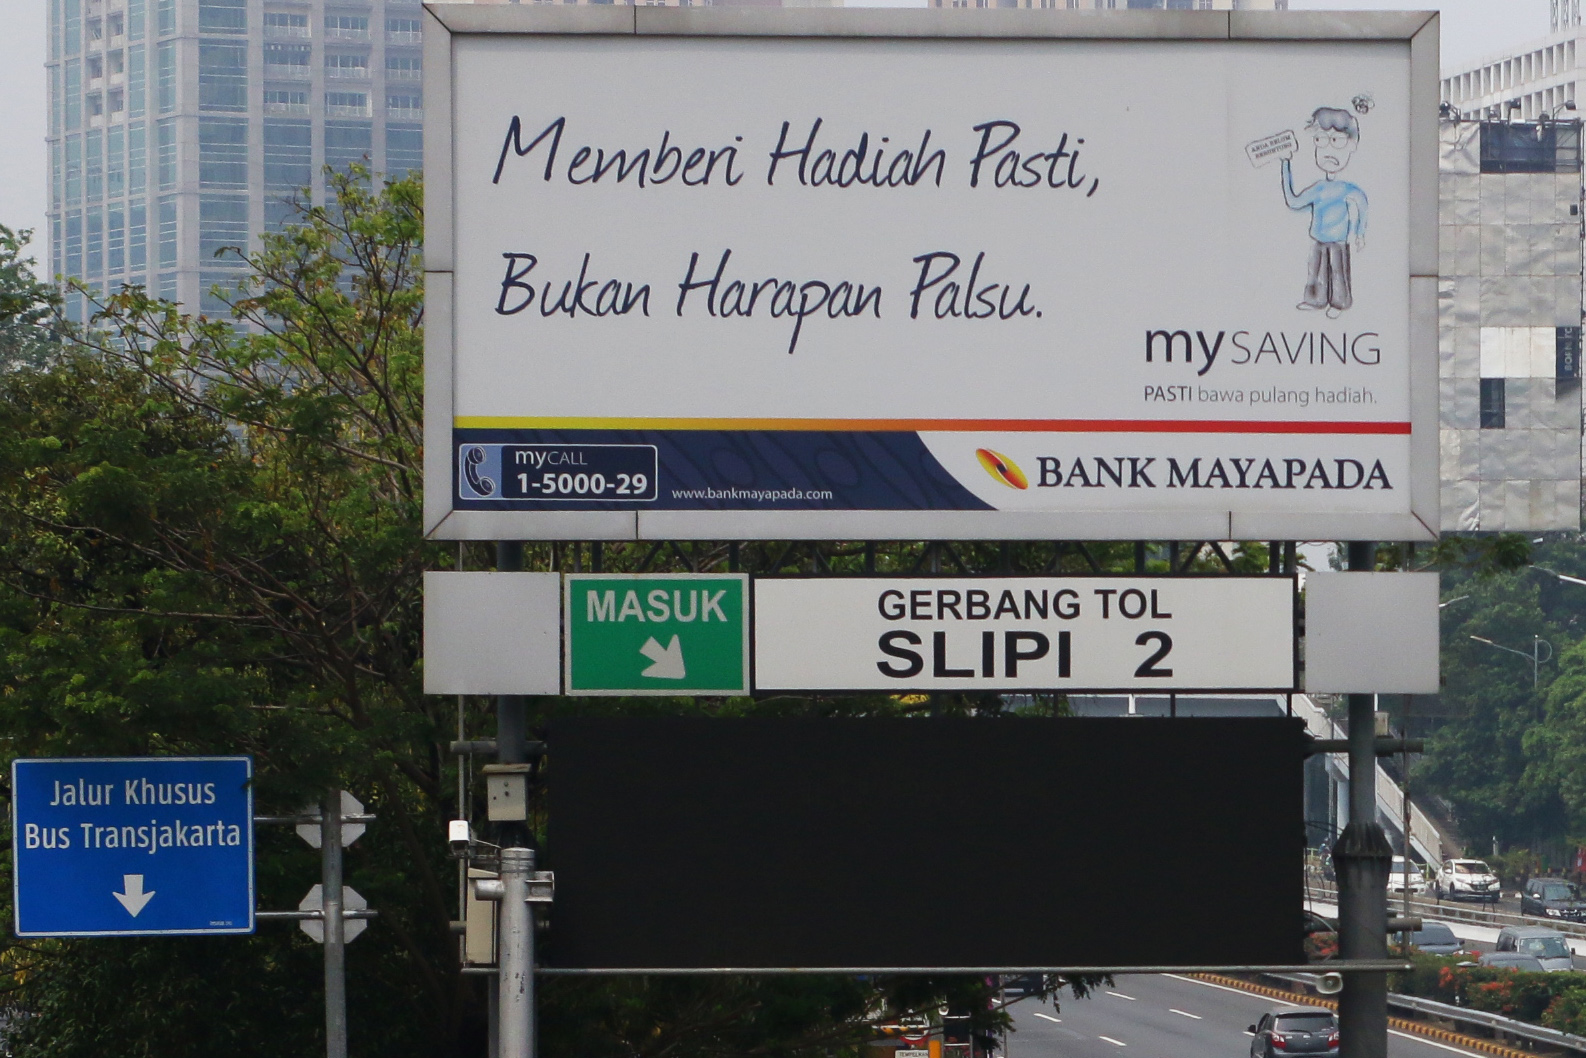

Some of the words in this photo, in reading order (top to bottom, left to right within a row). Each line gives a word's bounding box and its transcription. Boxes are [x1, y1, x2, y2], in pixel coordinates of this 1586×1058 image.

[493, 114, 743, 189] Memberi
[766, 115, 947, 188] Hadiah
[968, 118, 1100, 198] Pasti,
[494, 250, 650, 318] Bukan
[675, 248, 883, 355] Harapan
[908, 250, 1044, 320] Palsu.
[1143, 385, 1193, 402] PASTI
[1198, 385, 1245, 403] bawa
[1249, 385, 1310, 408] pulang
[1314, 385, 1378, 404] hadiah.
[515, 449, 588, 469] myCALL
[1036, 456, 1156, 490] BANK
[1166, 457, 1394, 490] MAYAPADA
[516, 473, 648, 495] 1-5000-29
[672, 486, 833, 502] www.bankmayapada.com
[585, 588, 728, 623] MASUK
[877, 588, 1081, 622] GERBANG
[1093, 588, 1173, 622] TOL
[876, 629, 1072, 680] SLIPI
[1133, 629, 1175, 679] 2
[50, 778, 114, 806] Jalur
[125, 777, 216, 805] Khusus
[25, 823, 70, 849] Bus
[80, 819, 240, 854] Transjakarta
